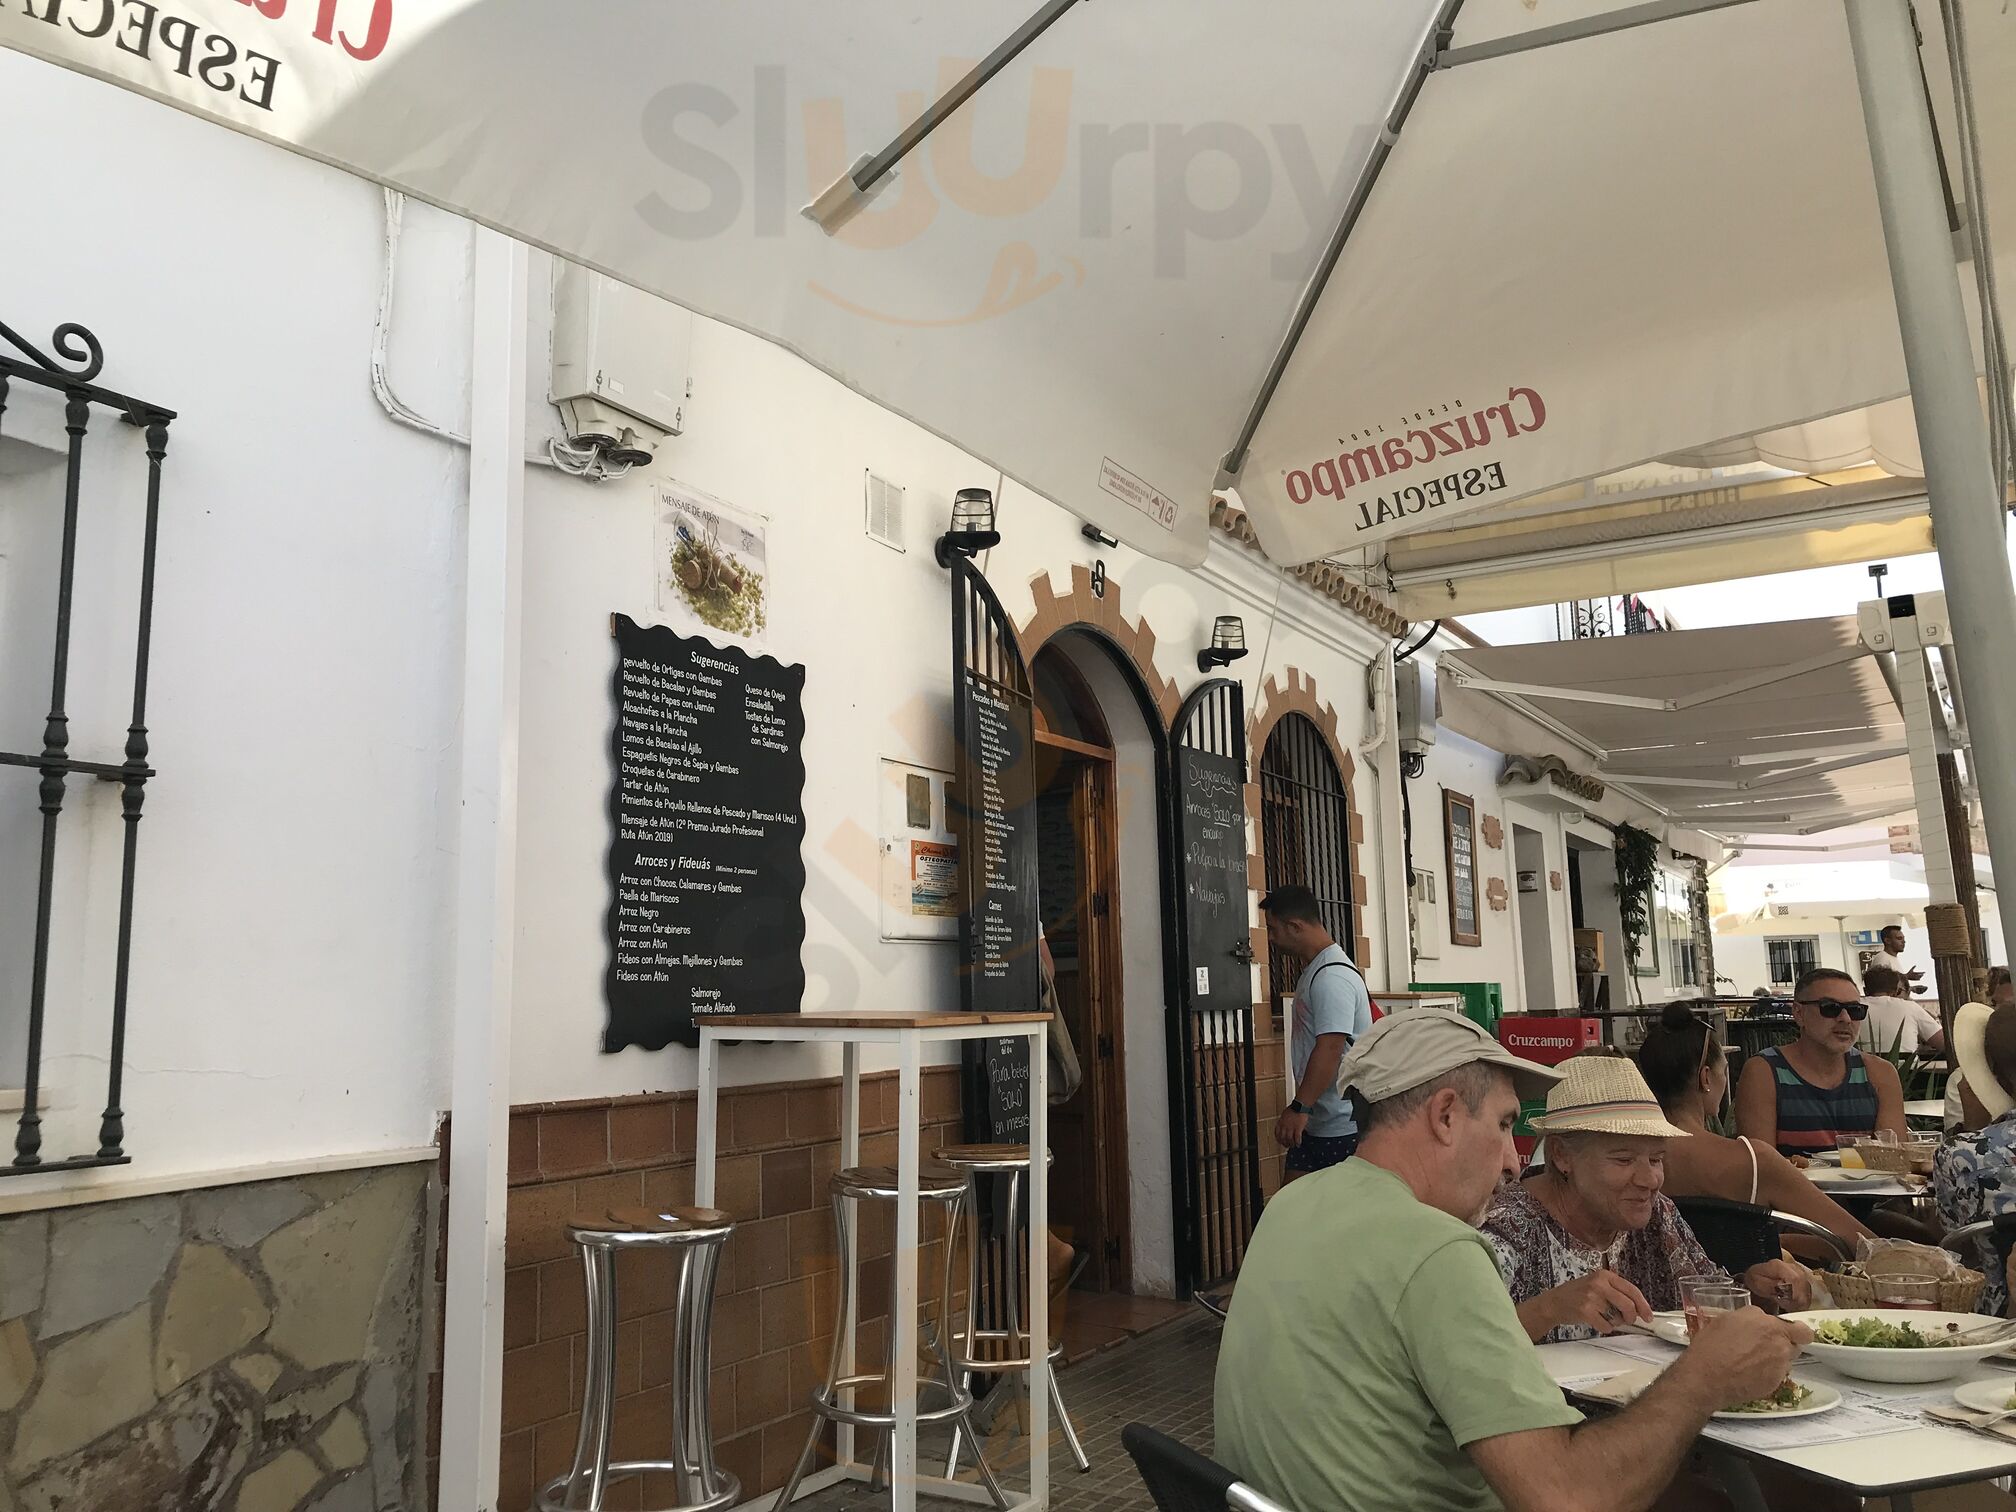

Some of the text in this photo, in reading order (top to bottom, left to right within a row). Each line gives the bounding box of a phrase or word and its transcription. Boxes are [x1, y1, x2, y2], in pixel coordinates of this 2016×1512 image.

[661, 493, 691, 514] MENSAJE
[691, 505, 701, 518] DE
[690, 650, 739, 675] Sugerencias
[623, 657, 722, 686] Revuelto de Ortigas con Gambas
[623, 669, 650, 685] Revuelto
[651, 676, 660, 688] de
[661, 677, 685, 692] Bacalao
[691, 684, 717, 699] Gambas
[744, 683, 786, 702] Queso de Oveja
[622, 684, 715, 713] Revuelto de Papas con Jamón
[745, 696, 774, 712] Ensaladilla
[972, 690, 990, 705] Pescados
[622, 700, 659, 717] Alcachofas
[666, 707, 672, 720] la
[673, 709, 697, 725] Plancha
[744, 710, 785, 726] Tostas de Lomo
[622, 715, 648, 731] Navajas
[655, 720, 661, 733] la
[662, 722, 687, 737] Plancha
[751, 722, 784, 737] de Sardinas
[622, 730, 702, 754] Lomos de Bacalao al Ajillo
[750, 736, 789, 753] con Salmorejo
[622, 745, 658, 762] Espaguetis
[658, 752, 681, 766] Negros
[682, 756, 691, 768] de
[692, 757, 709, 771] Sepia
[714, 761, 739, 774] Gambas
[621, 761, 700, 783] Croquetas de Carabinero
[621, 777, 669, 794] Tartar de Atún
[621, 792, 653, 807] Pimientos
[654, 797, 663, 808] de
[663, 798, 686, 812] Piquillo
[686, 801, 712, 814] Rellenos
[712, 804, 721, 815] de
[721, 805, 746, 818] Pescado
[751, 809, 774, 821] Marisco
[621, 812, 648, 827] Mensaje
[649, 815, 658, 827] de
[658, 816, 675, 828] Atún
[687, 819, 709, 832] Premio
[709, 822, 731, 834] Jurado
[731, 823, 764, 837] Profesional
[620, 828, 673, 842] Ruta Atún 2019)
[634, 853, 668, 868] Arroces
[677, 856, 711, 870] Fideuás
[619, 872, 639, 885] Arroz
[639, 877, 652, 886] con
[678, 877, 711, 891] Calamares
[717, 881, 742, 893] Gambas
[619, 888, 679, 903] Paella de Mariscos
[618, 904, 659, 920] Arroz Negro
[988, 900, 1002, 912] Carnes
[617, 920, 691, 934] Arroz con Carabineros
[617, 936, 668, 949] Arroz con Atún
[617, 952, 640, 964] Fideos
[640, 956, 653, 964] con
[682, 953, 712, 968] Mejillones
[718, 954, 743, 966] Gambas
[616, 969, 669, 982] Fideos con Atún
[690, 986, 721, 999] Salmorejo
[690, 1002, 736, 1013] Tomate Aliñado
[1508, 1034, 1574, 1049] Cruzcampo
